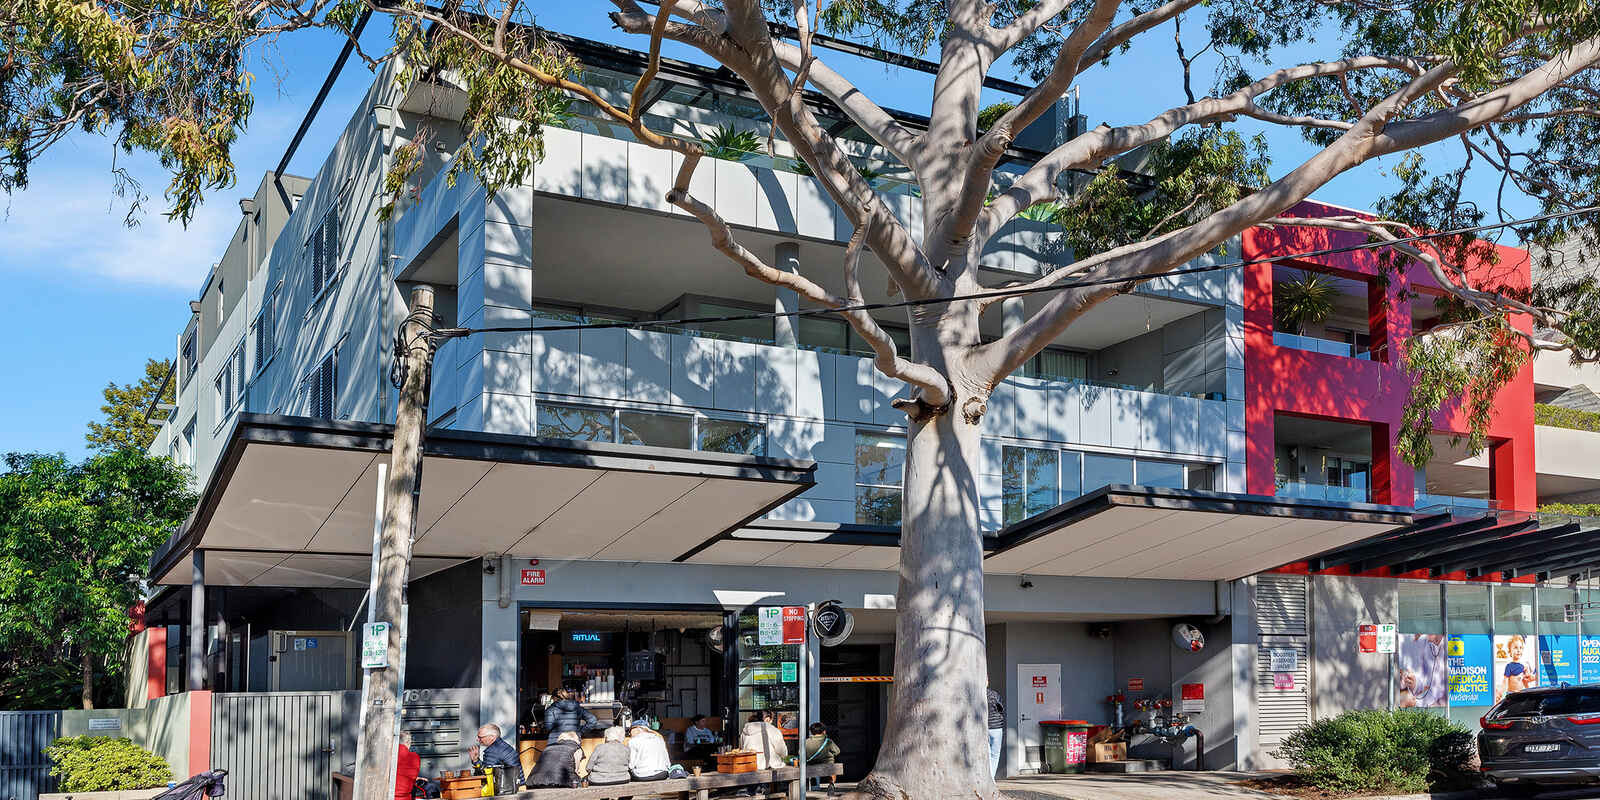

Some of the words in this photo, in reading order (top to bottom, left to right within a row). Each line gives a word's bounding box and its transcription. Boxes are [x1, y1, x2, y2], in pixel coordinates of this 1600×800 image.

[766, 608, 779, 618] 1P
[371, 624, 386, 636] 1P
[1382, 625, 1394, 633] 1P
[1448, 657, 1464, 666] THE
[1448, 666, 1487, 674] MADISON
[1448, 675, 1488, 683] MEDICAL
[1448, 684, 1489, 692] PRACTICE
[402, 688, 431, 702] 160
